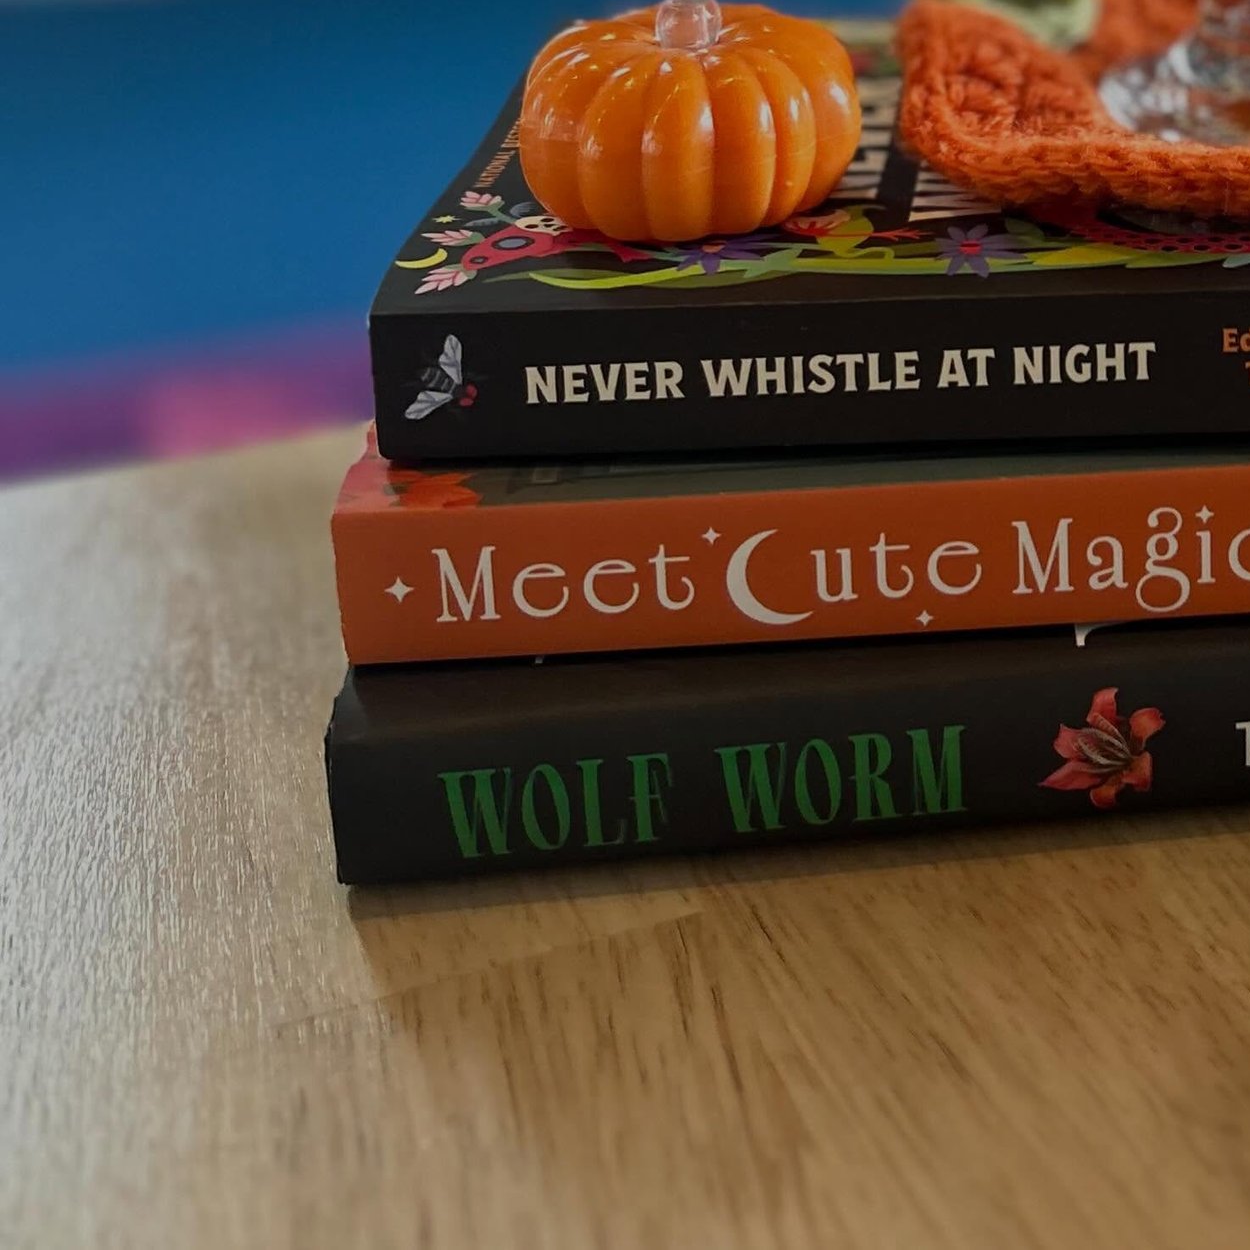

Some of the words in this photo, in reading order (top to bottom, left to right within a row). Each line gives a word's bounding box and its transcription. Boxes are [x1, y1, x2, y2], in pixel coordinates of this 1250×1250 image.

[525, 360, 685, 406] NEVER
[699, 350, 921, 399] WHISTLE
[937, 347, 996, 389] AT
[1012, 341, 1157, 386] NIGHT
[431, 543, 695, 623] Meet
[725, 528, 983, 625] Cute
[437, 753, 674, 859] WOLF
[713, 725, 967, 833] WORM
